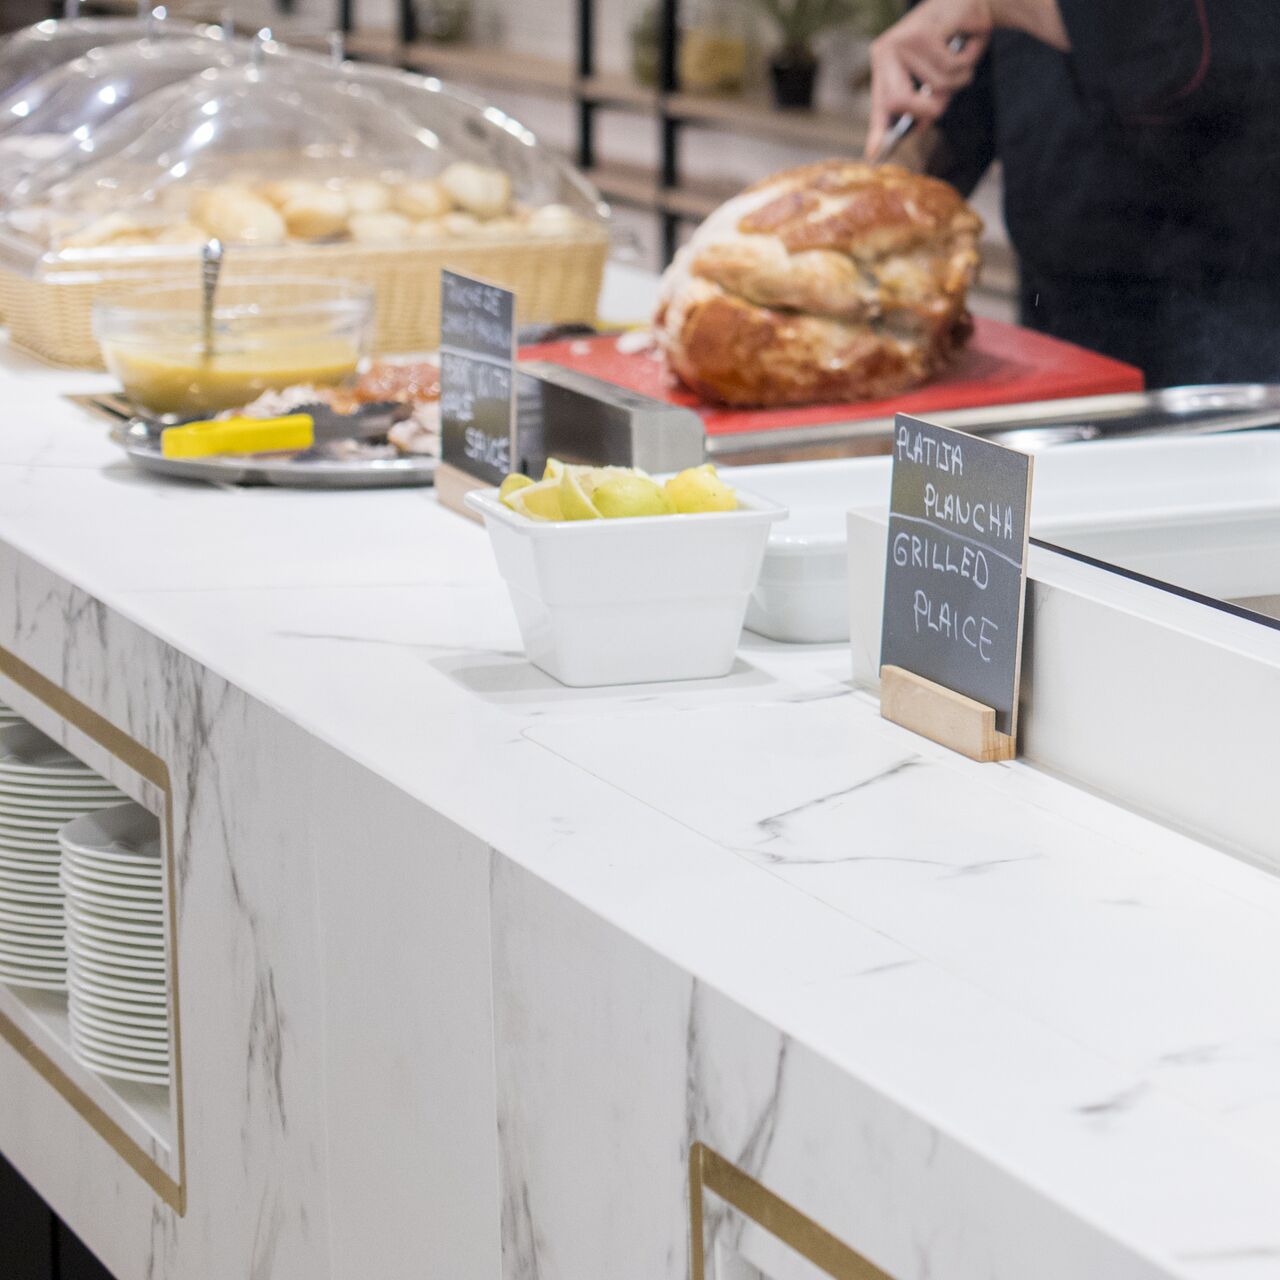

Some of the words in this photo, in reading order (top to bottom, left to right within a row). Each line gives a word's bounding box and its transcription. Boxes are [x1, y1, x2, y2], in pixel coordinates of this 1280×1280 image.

[896, 426, 964, 476] PLATIJA
[923, 483, 1014, 540] PLANCHA
[893, 532, 989, 591] GRILLED
[914, 589, 998, 663] PLAICE
